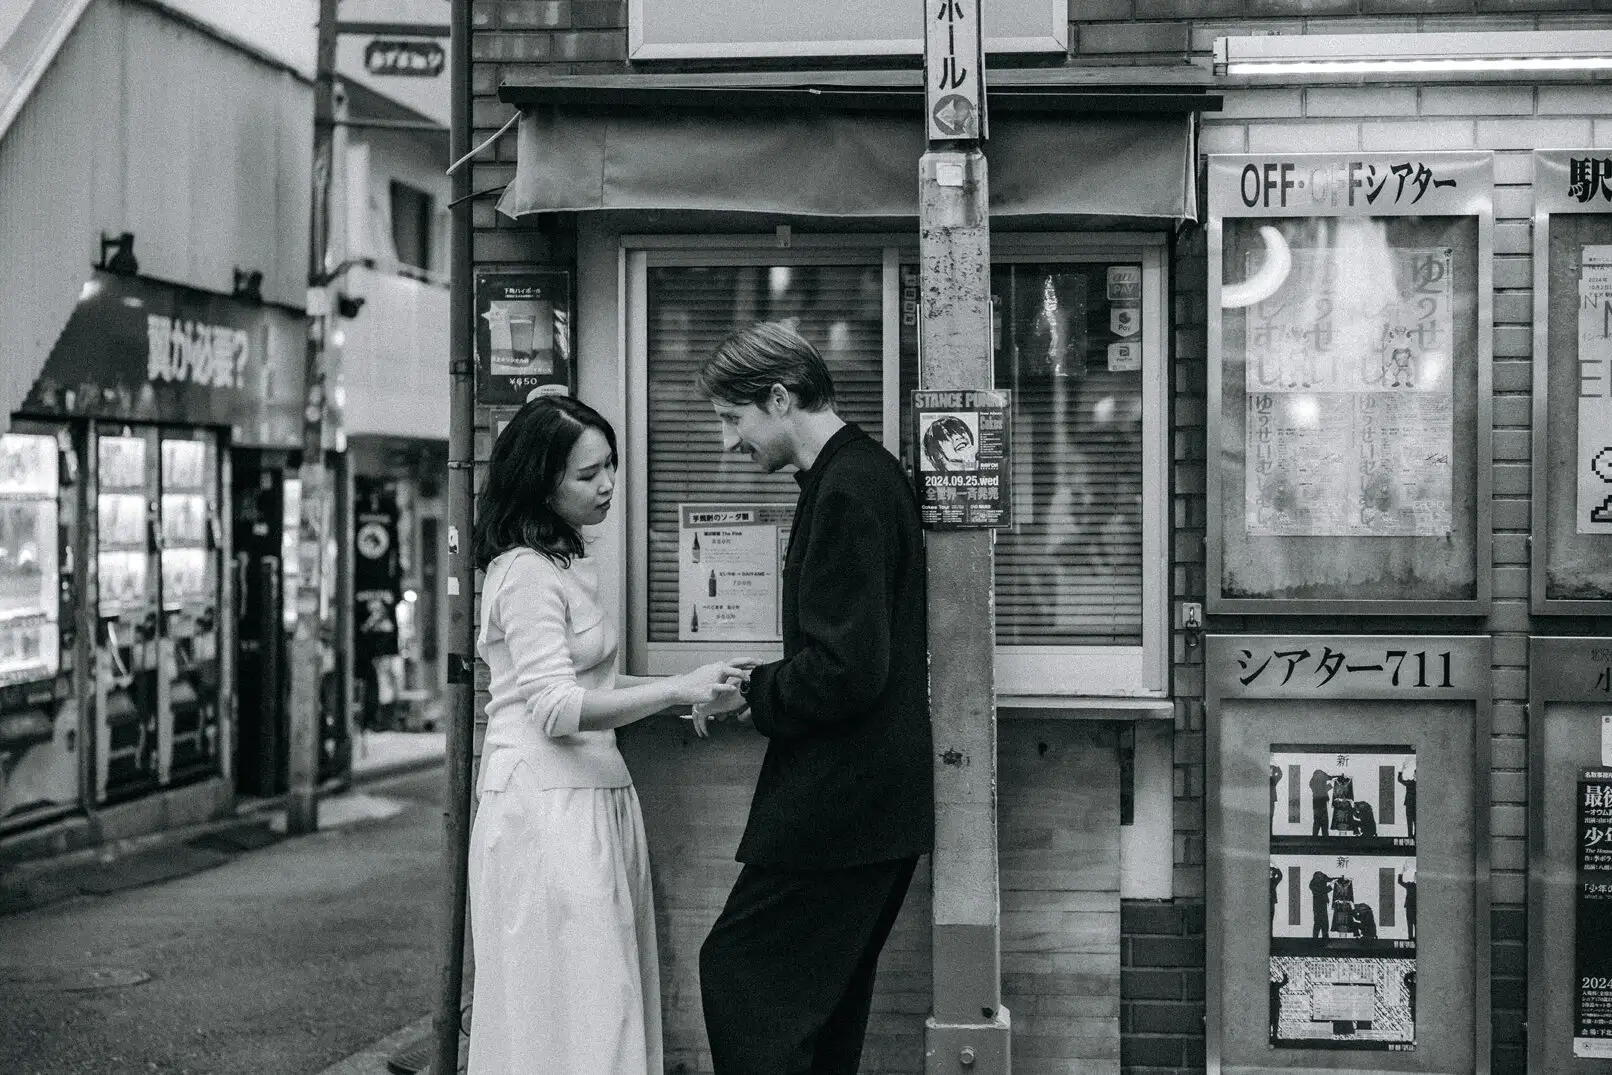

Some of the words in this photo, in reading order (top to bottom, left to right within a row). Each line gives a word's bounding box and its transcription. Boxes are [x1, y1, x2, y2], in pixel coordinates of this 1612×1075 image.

[914, 393, 963, 408] STANCE
[925, 475, 999, 487] 2024.09.25.wed
[1236, 646, 1455, 689] シアター711
[1336, 754, 1350, 768] 新
[1336, 856, 1350, 869] 新
